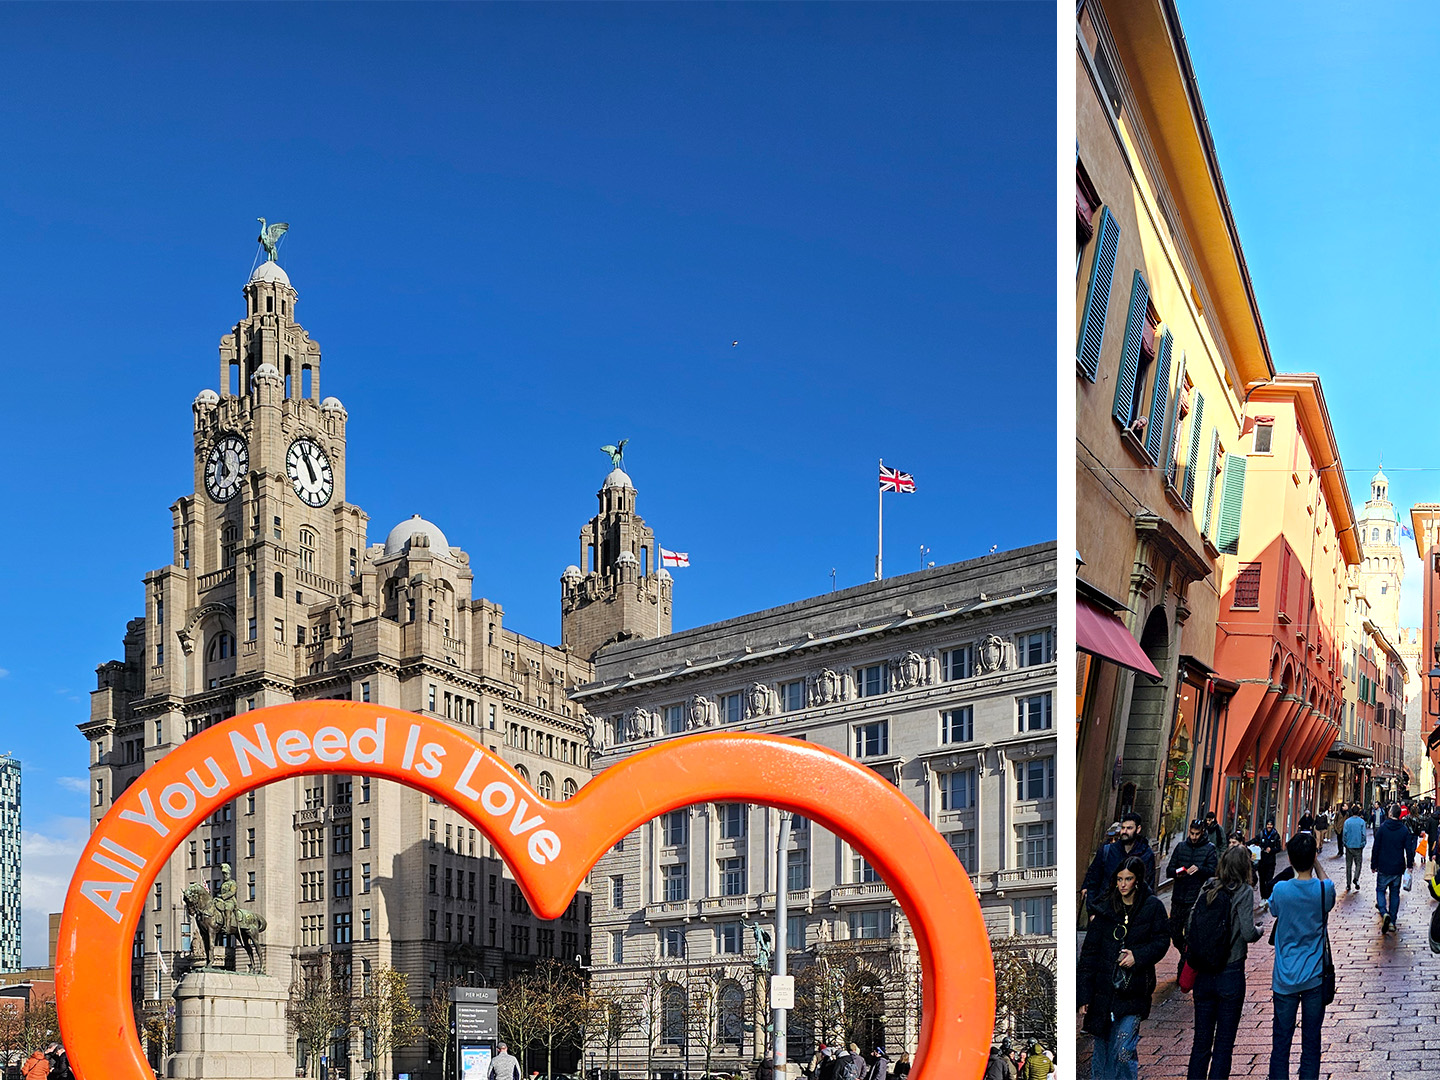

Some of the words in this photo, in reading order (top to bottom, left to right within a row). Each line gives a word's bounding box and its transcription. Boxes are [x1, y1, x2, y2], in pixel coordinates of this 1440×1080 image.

[80, 837, 147, 923] All
[118, 756, 230, 838] You
[227, 717, 387, 778] Need
[401, 724, 446, 778] Is
[454, 750, 561, 866] Love
